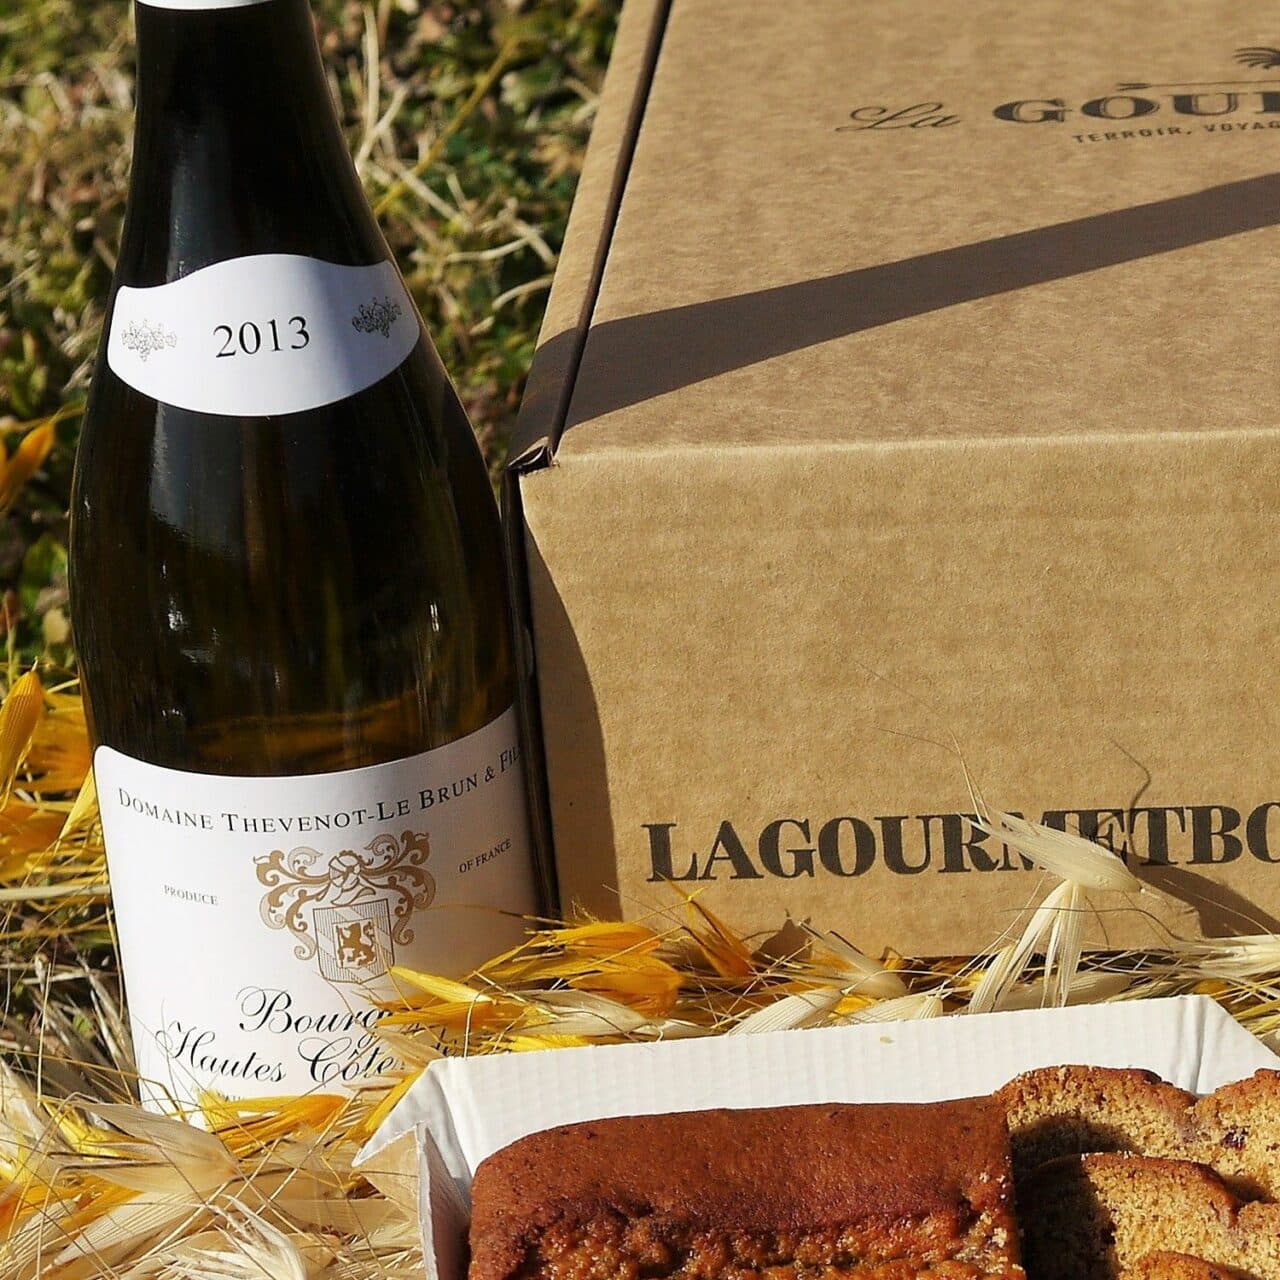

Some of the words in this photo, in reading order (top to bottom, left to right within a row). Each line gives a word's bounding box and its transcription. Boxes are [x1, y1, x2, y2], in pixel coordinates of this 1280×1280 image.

[835, 102, 961, 132] La
[1072, 126, 1193, 144] TERROIR,
[213, 316, 310, 358] 2013
[118, 787, 214, 830] DOMAINE
[418, 773, 478, 810] BRUN
[484, 766, 496, 783] &
[499, 746, 521, 773] FIL
[459, 862, 474, 873] OF
[475, 839, 512, 867] FRANCE
[163, 884, 219, 906] PRODUCE
[155, 1020, 287, 1083] Hautes
[298, 1036, 405, 1088] Côte
